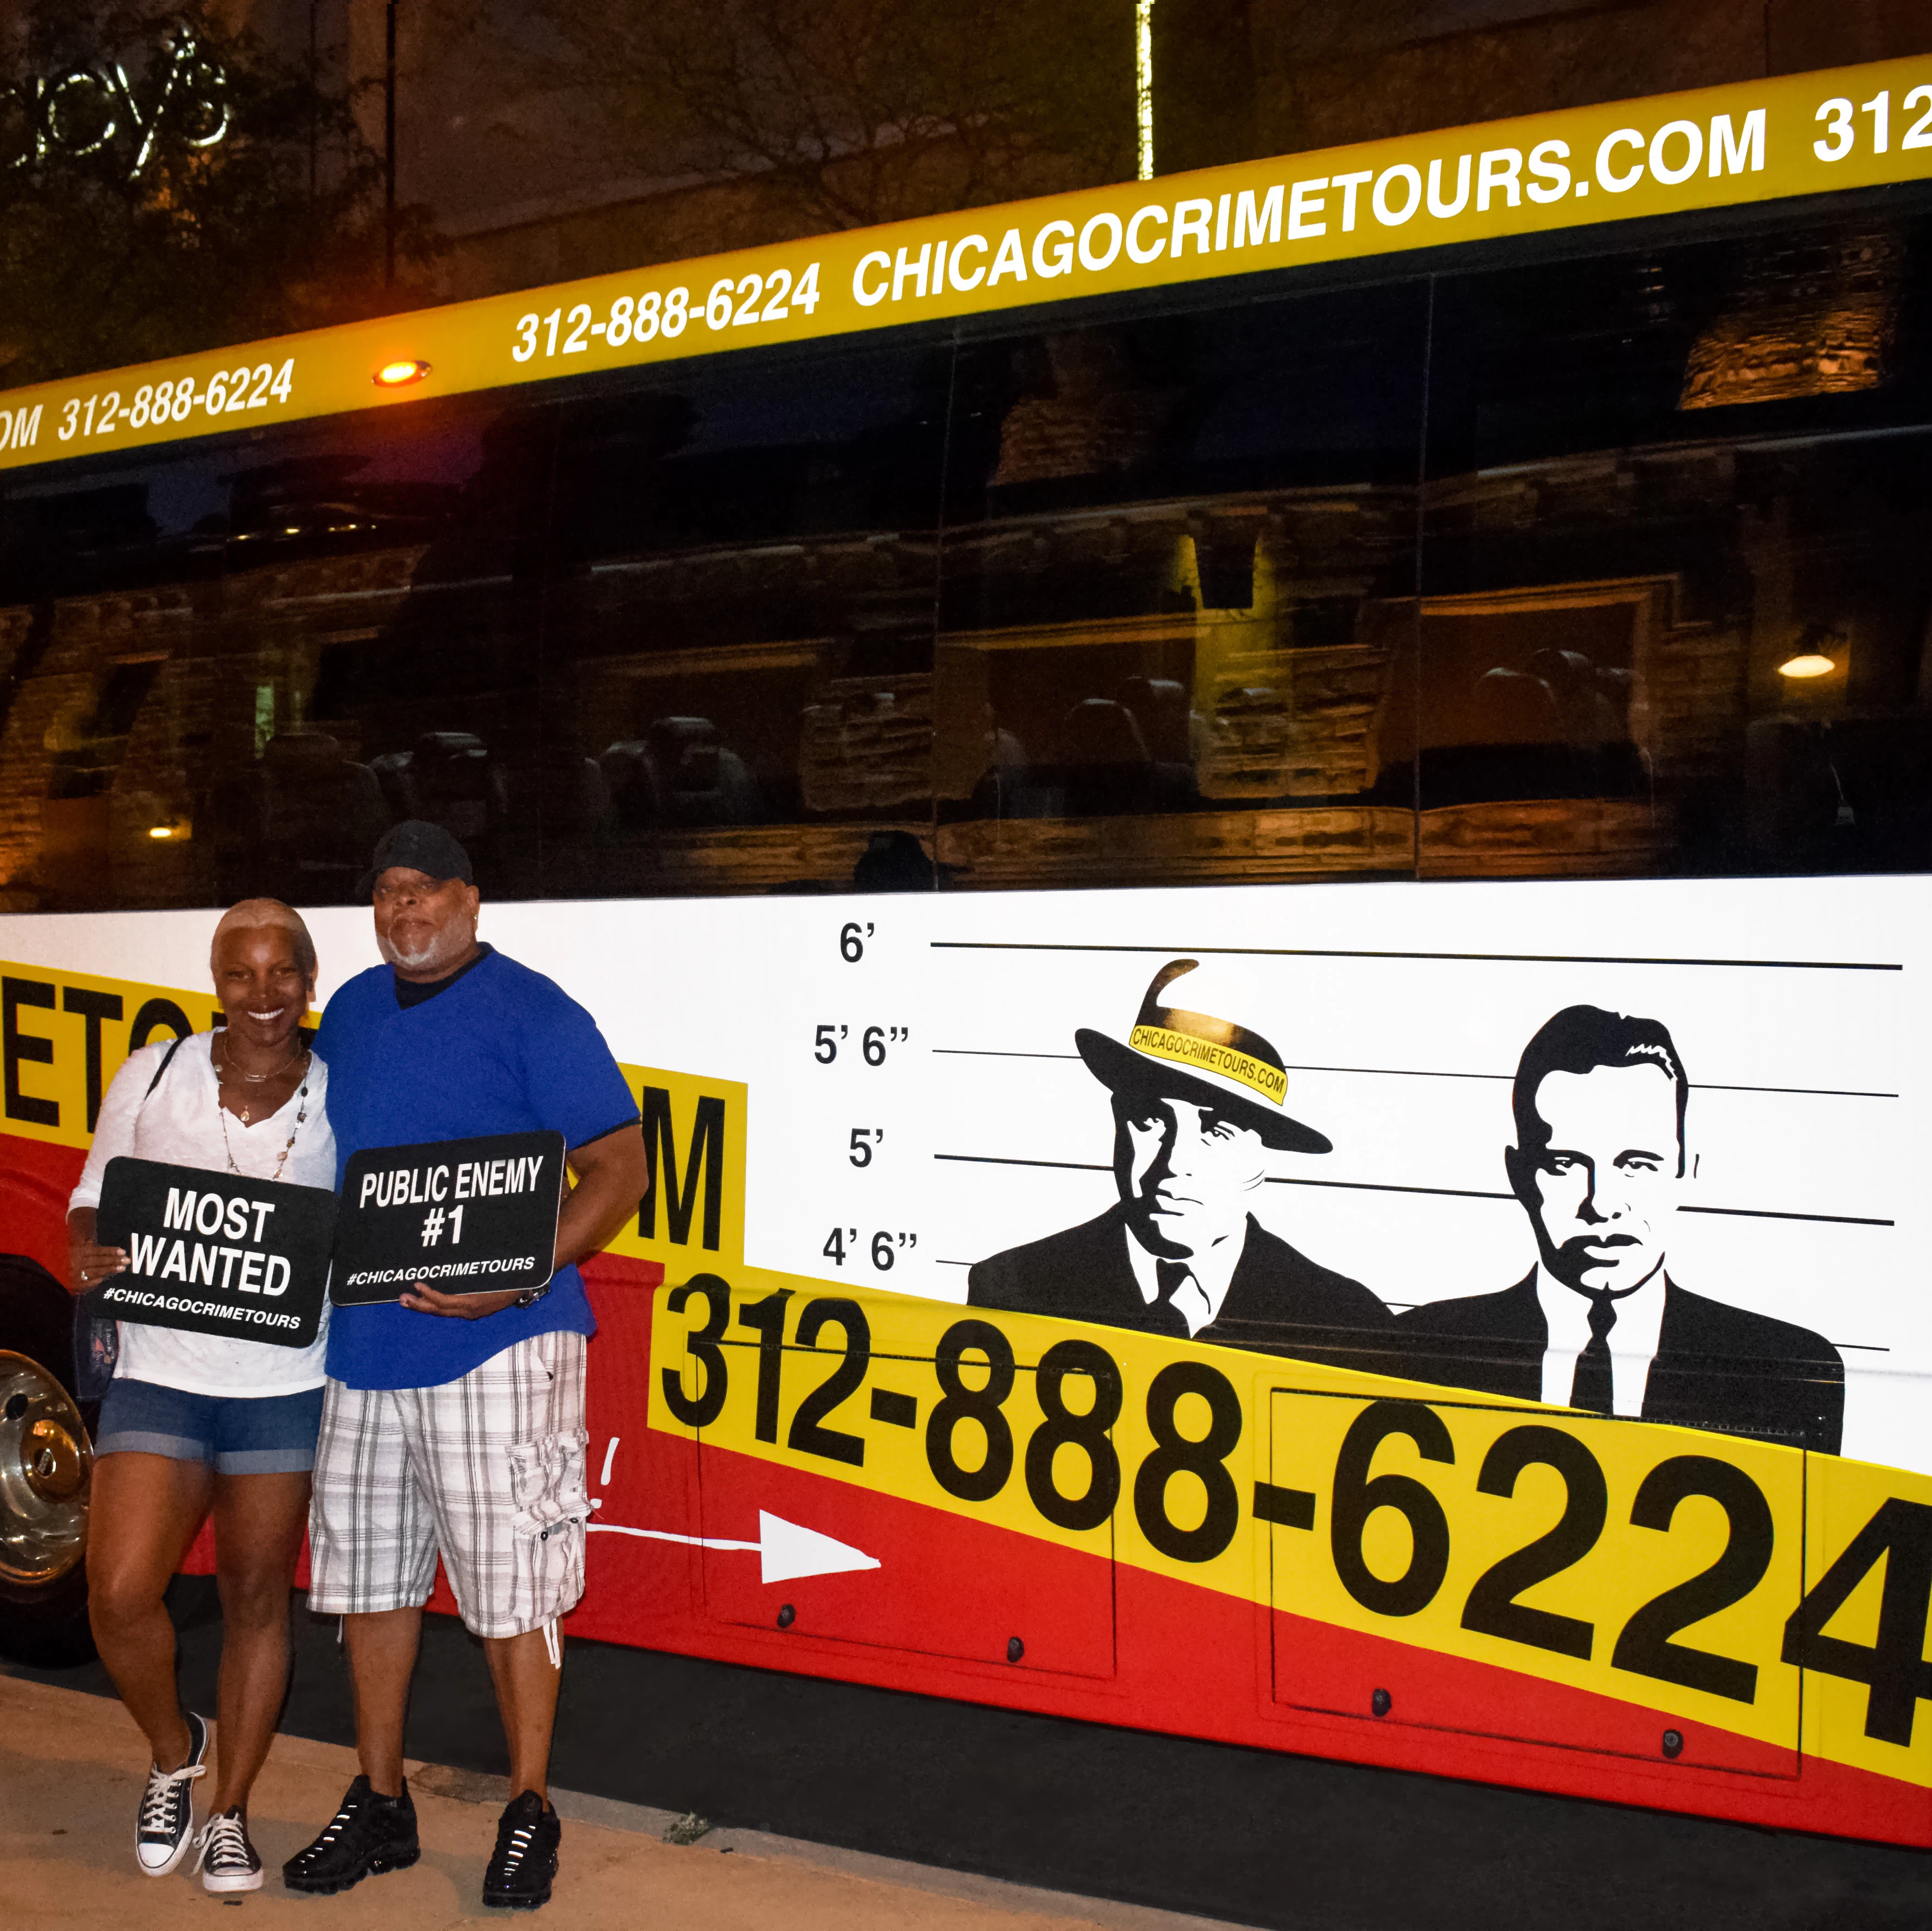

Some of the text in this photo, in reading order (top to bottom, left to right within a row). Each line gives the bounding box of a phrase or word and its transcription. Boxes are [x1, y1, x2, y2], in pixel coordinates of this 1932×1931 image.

[58, 358, 295, 440] 312-888-6224
[512, 262, 821, 362] 312-888-6224
[852, 108, 1767, 306] CHICAGOCRIMETOURS.COM
[1813, 85, 1932, 162] 312
[1133, 1028, 1285, 1094] CHICAGOCRIMETOURS.COM
[360, 1156, 543, 1209] PUBLIC ENEMY
[163, 1187, 276, 1243] MOST
[421, 1204, 464, 1247] #1
[130, 1232, 291, 1297] WANTED
[347, 1256, 535, 1286] #CHICAGOCRIMETOURS
[103, 1287, 302, 1330] #CHICAGOCRIMETOURS
[661, 1272, 1932, 1748] 312-888-6224
